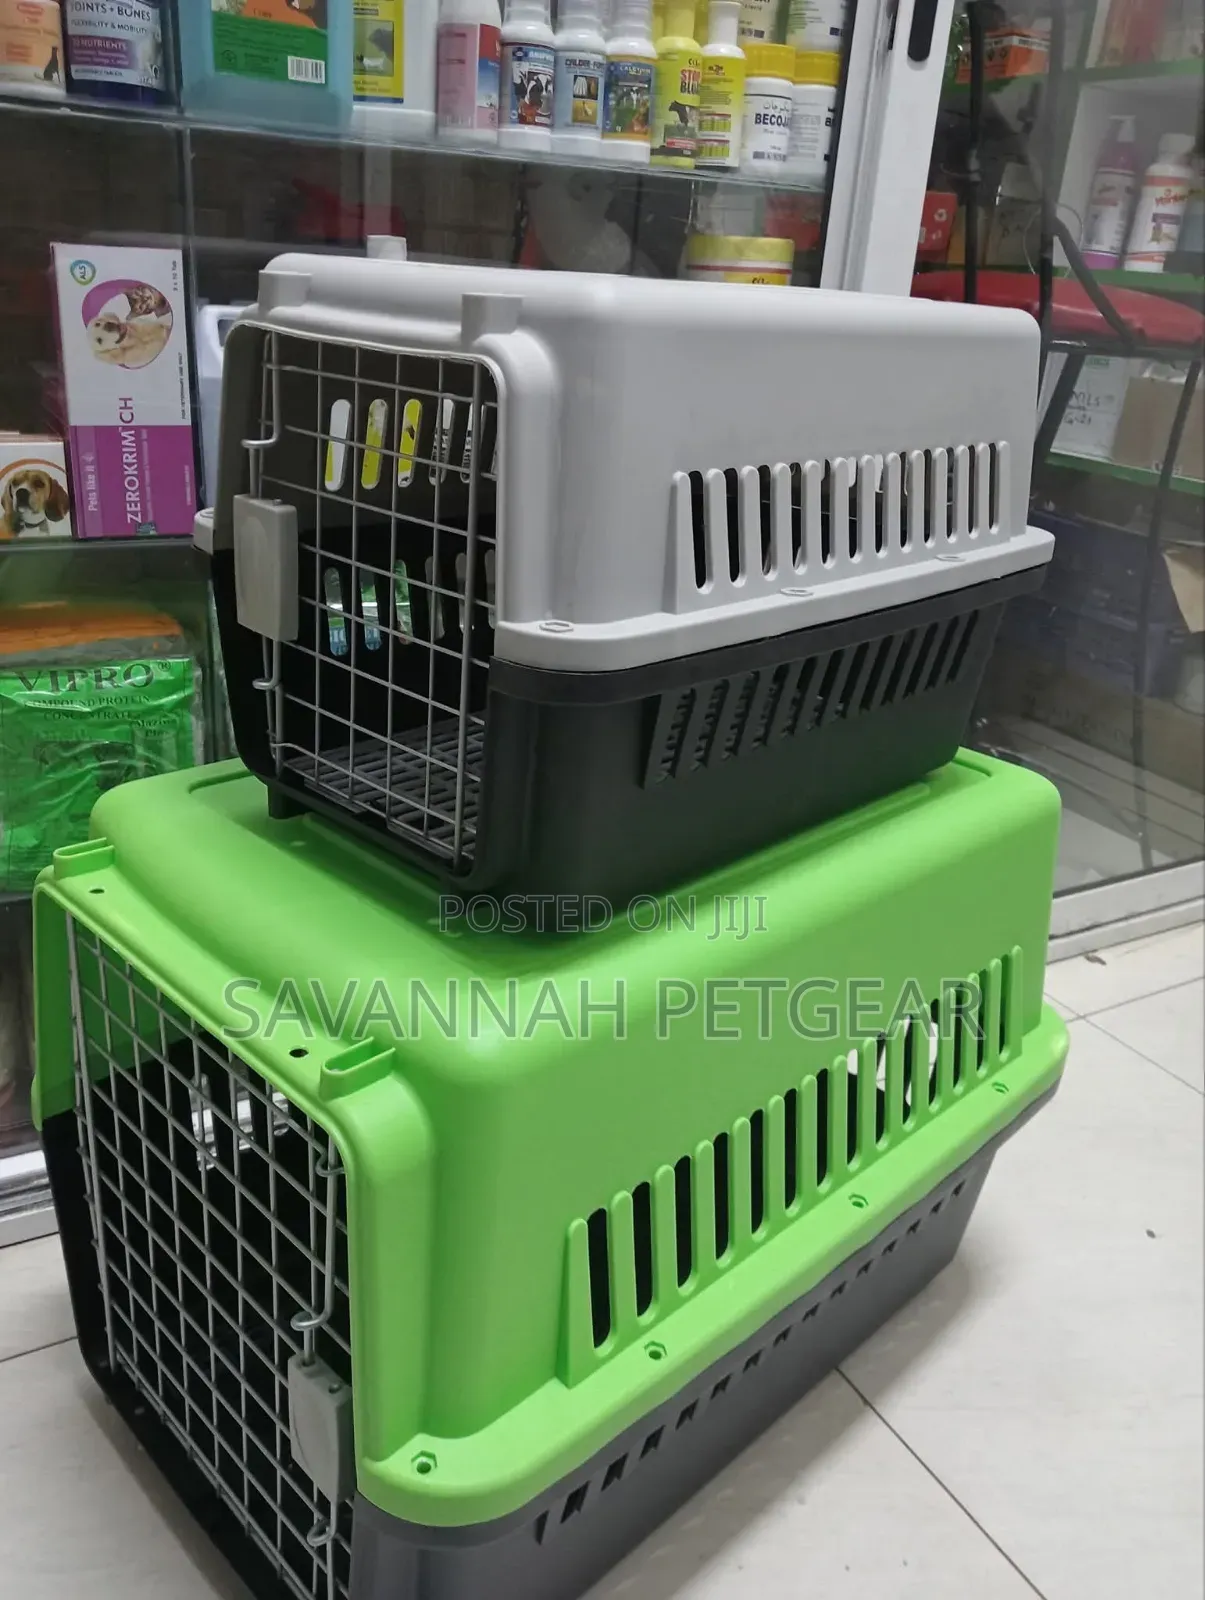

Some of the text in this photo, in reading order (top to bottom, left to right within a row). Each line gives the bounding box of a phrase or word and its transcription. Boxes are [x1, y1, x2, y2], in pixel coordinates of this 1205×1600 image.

[117, 6, 151, 22] BONES
[117, 23, 148, 35] MOBILITY
[81, 38, 127, 51] NUTRIENTS
[119, 397, 142, 524] ZEROKRIM CH
[15, 663, 154, 692] VIPRO
[30, 694, 151, 707] OMPOUND PROTEIN
